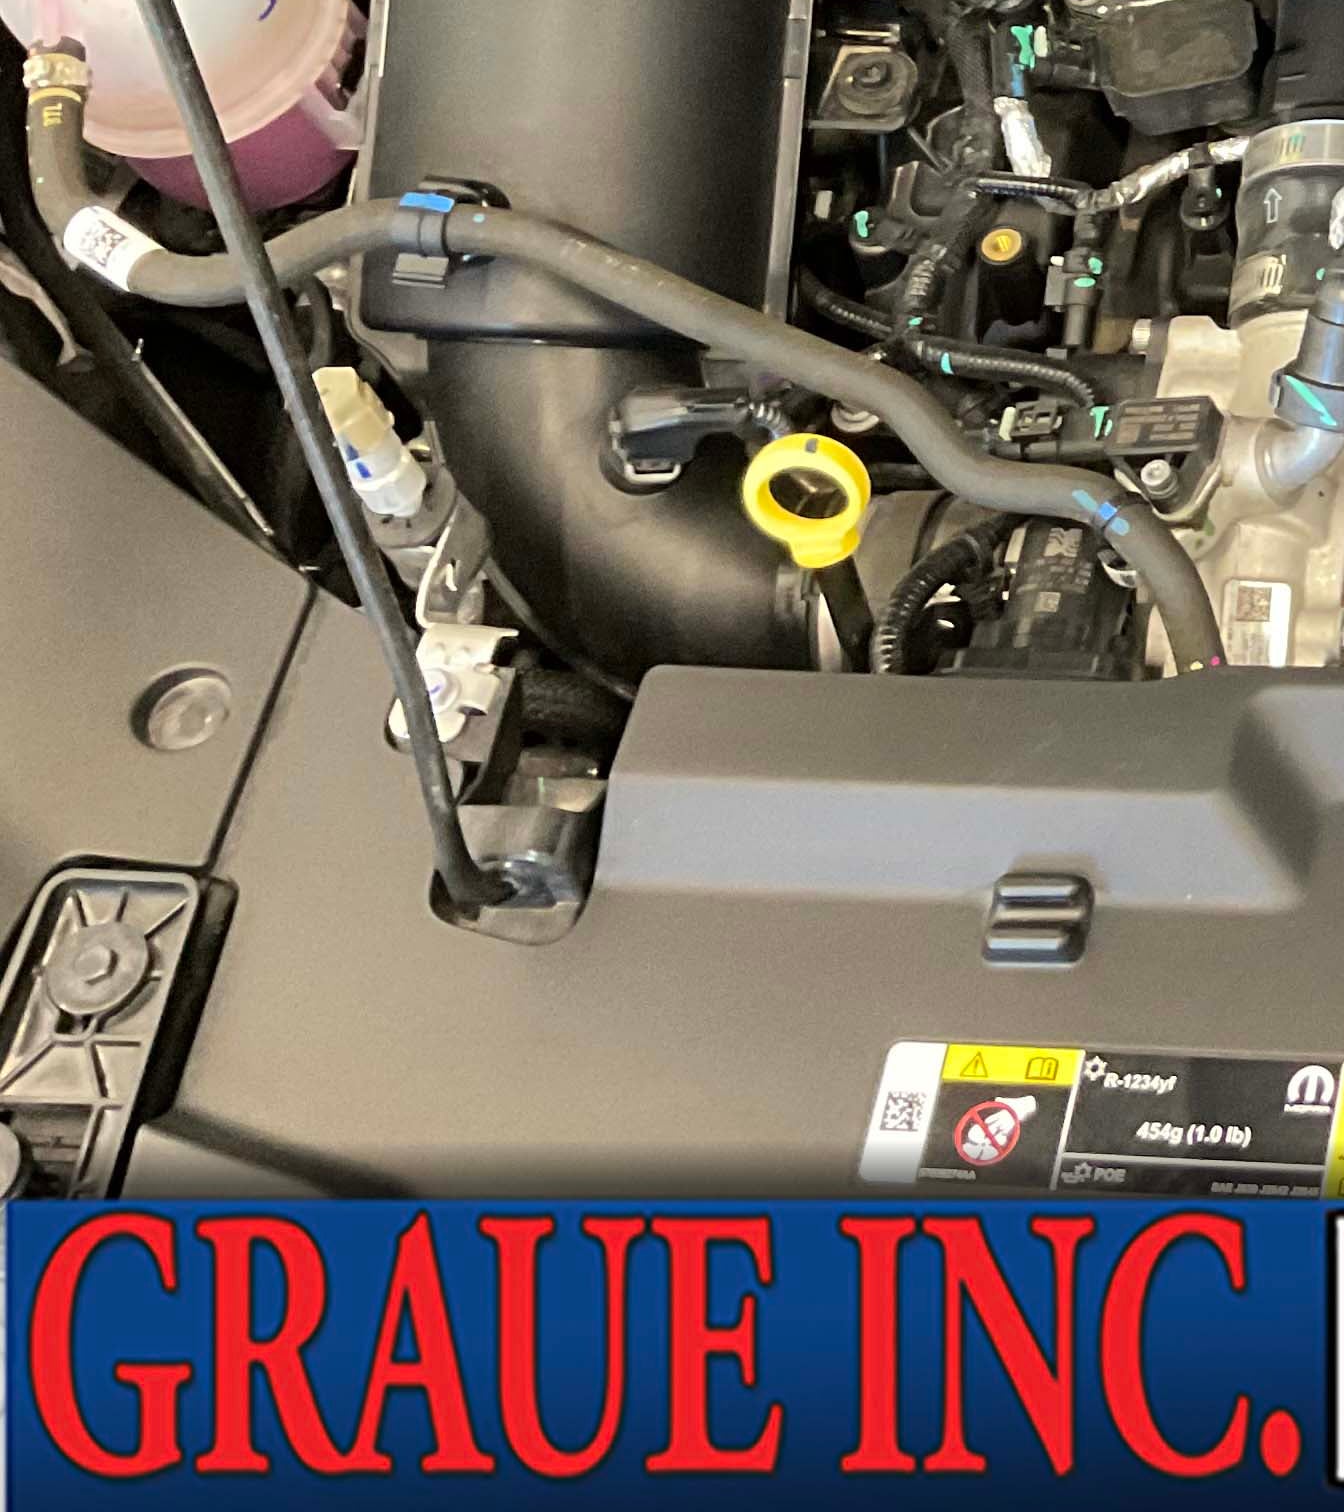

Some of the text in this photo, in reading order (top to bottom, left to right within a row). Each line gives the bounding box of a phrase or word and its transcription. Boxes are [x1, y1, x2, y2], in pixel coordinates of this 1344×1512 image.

[1103, 1072, 1178, 1095] R-1234yf
[1136, 1121, 1252, 1149] 454g (1.0 lb)
[1093, 1166, 1126, 1183] POE
